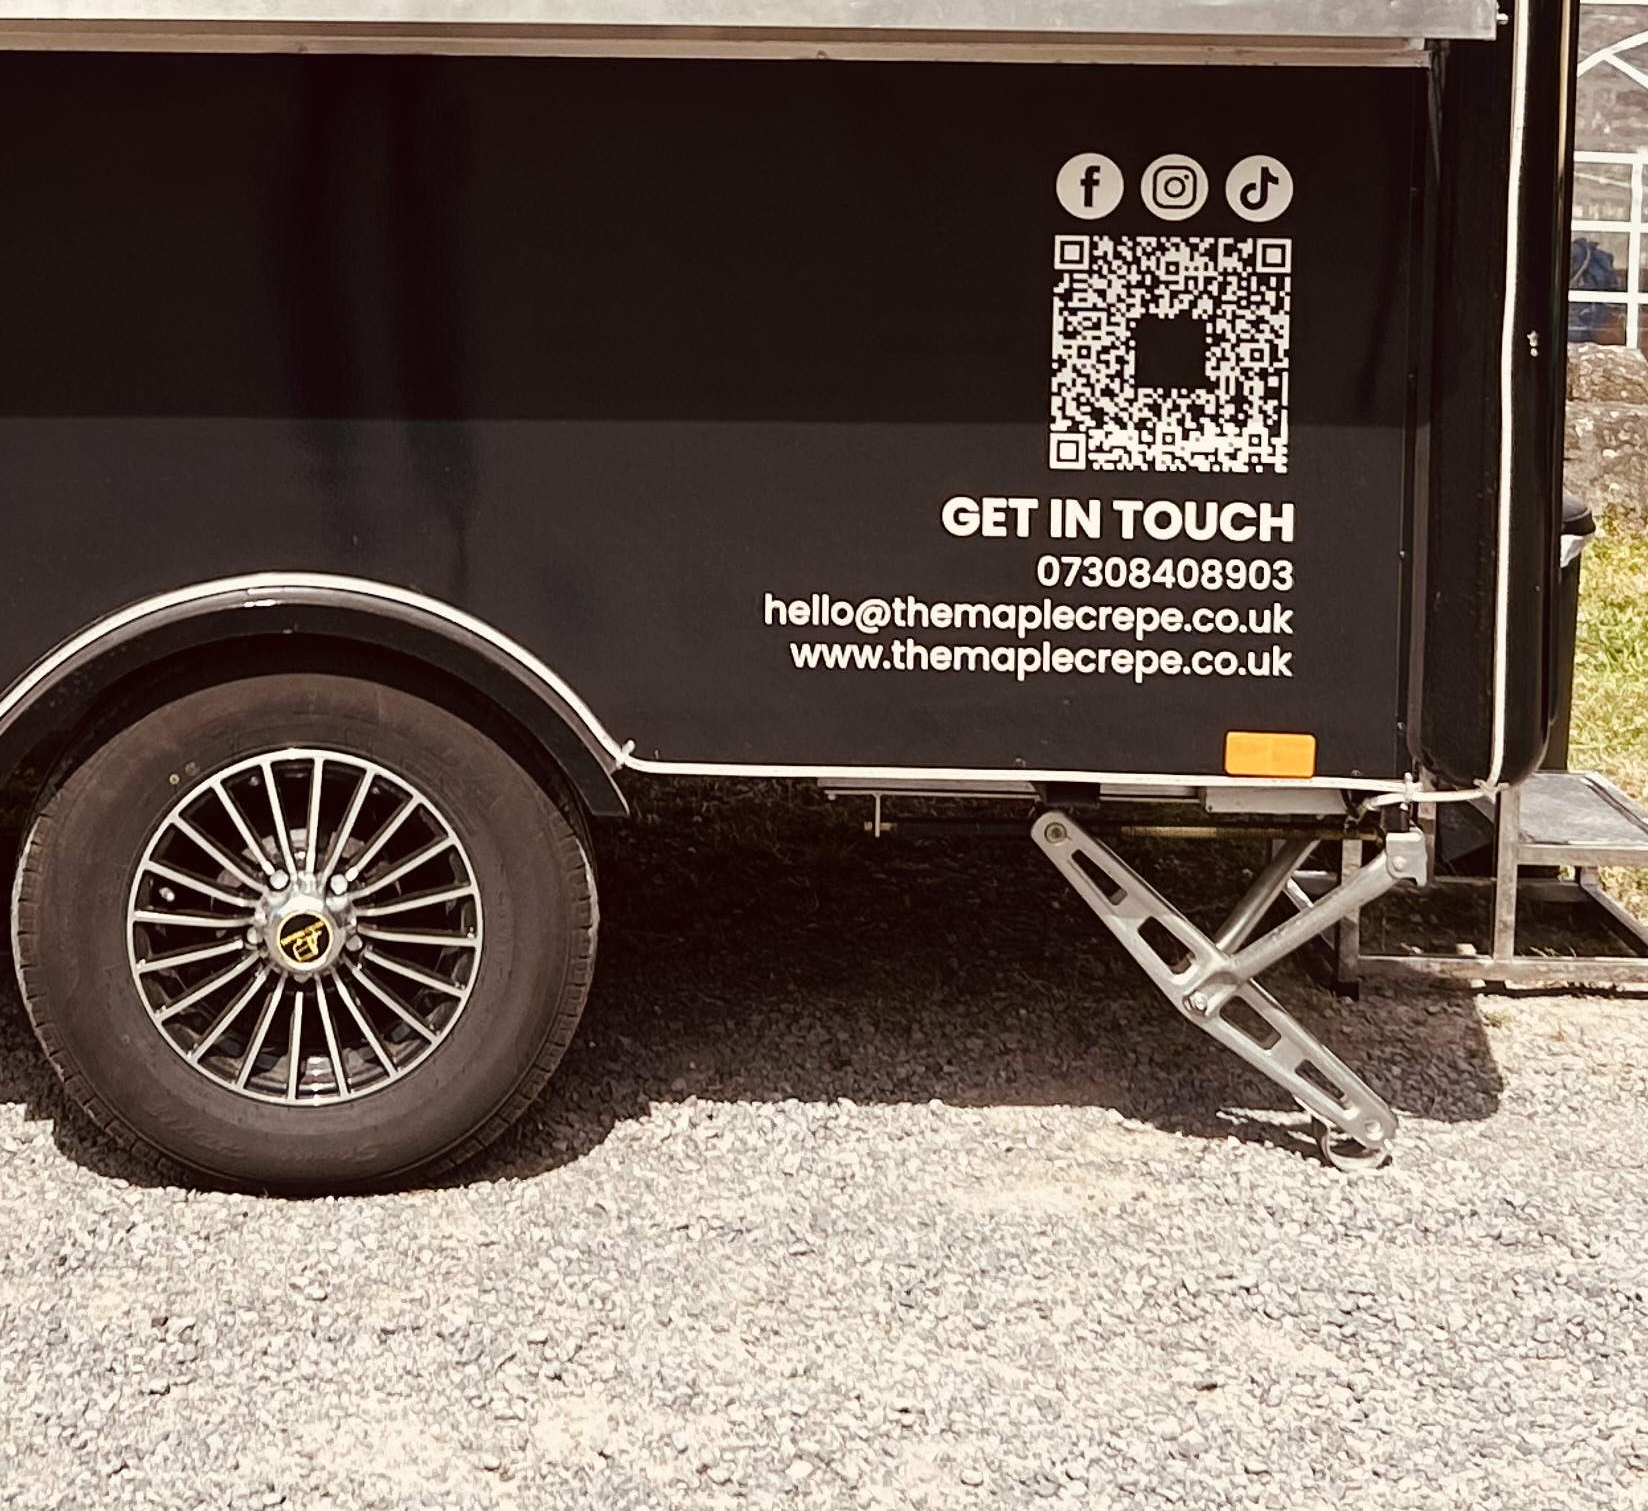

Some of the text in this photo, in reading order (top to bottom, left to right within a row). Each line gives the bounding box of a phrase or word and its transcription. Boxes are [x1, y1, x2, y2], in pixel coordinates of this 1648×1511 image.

[942, 496, 1296, 542] GET IN TOUCH
[1037, 555, 1294, 591] 07308408903
[763, 592, 1294, 640] hello@themaplecrepe.co.uk
[790, 639, 1293, 683] www.themaplecrepe.co.uk
